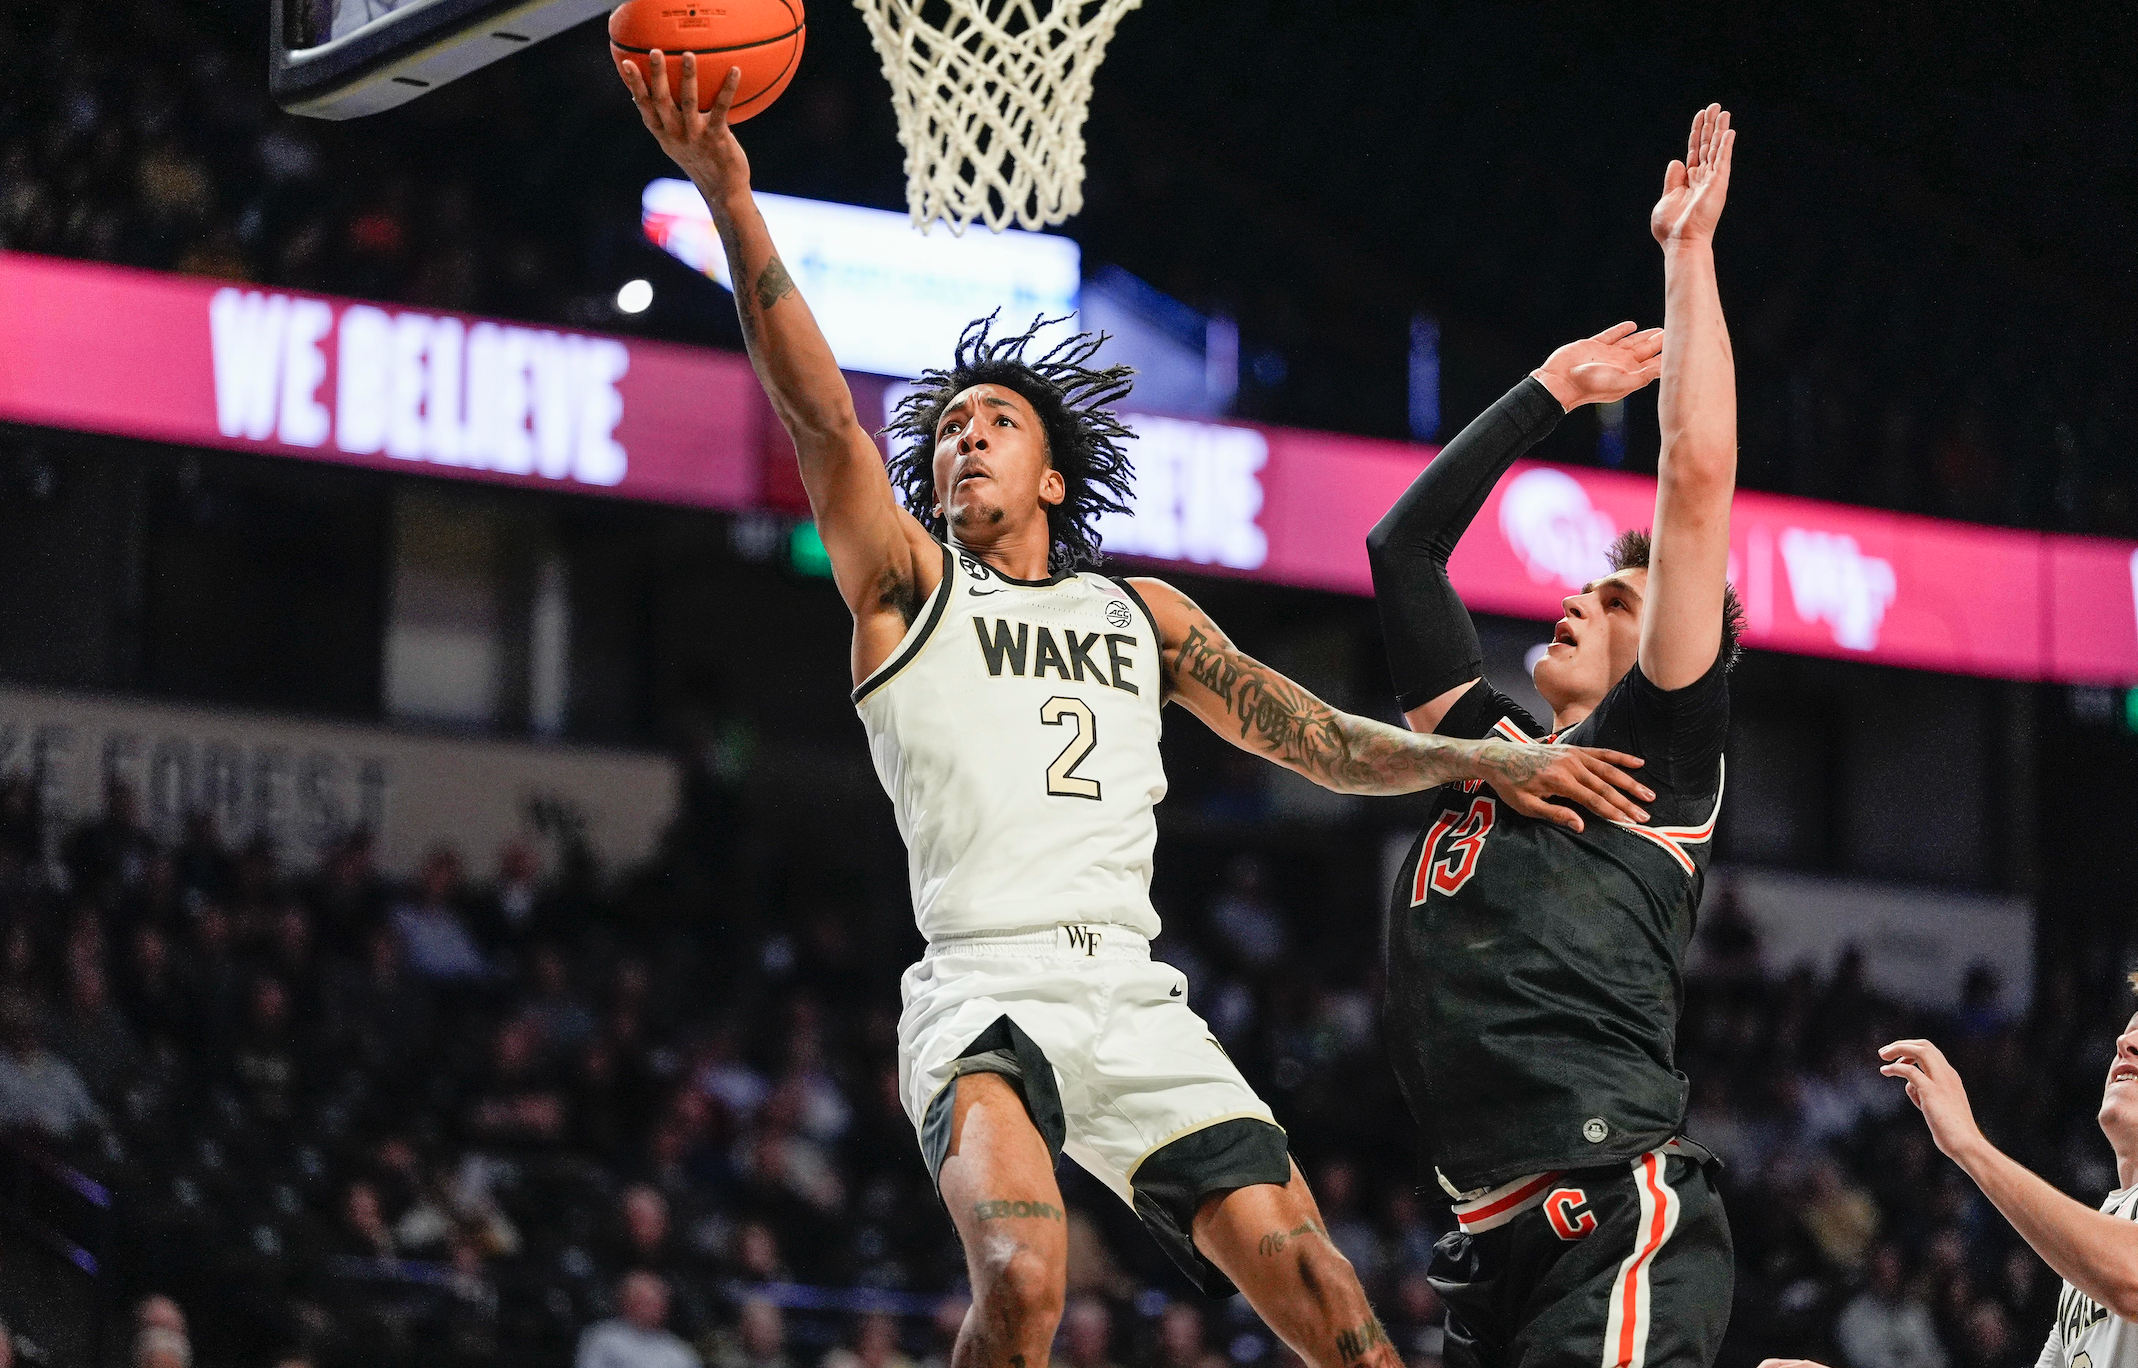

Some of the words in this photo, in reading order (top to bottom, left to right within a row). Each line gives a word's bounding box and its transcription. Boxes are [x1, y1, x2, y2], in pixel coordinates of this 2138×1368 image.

[210, 287, 332, 448] WE
[335, 303, 629, 487] BELIEVE
[1109, 609, 1130, 619] ACC
[972, 616, 1140, 697] WAKE
[1040, 695, 1102, 801] 2
[1410, 795, 1496, 908] 13
[1063, 925, 1103, 957] WF
[1542, 1187, 1599, 1241] C
